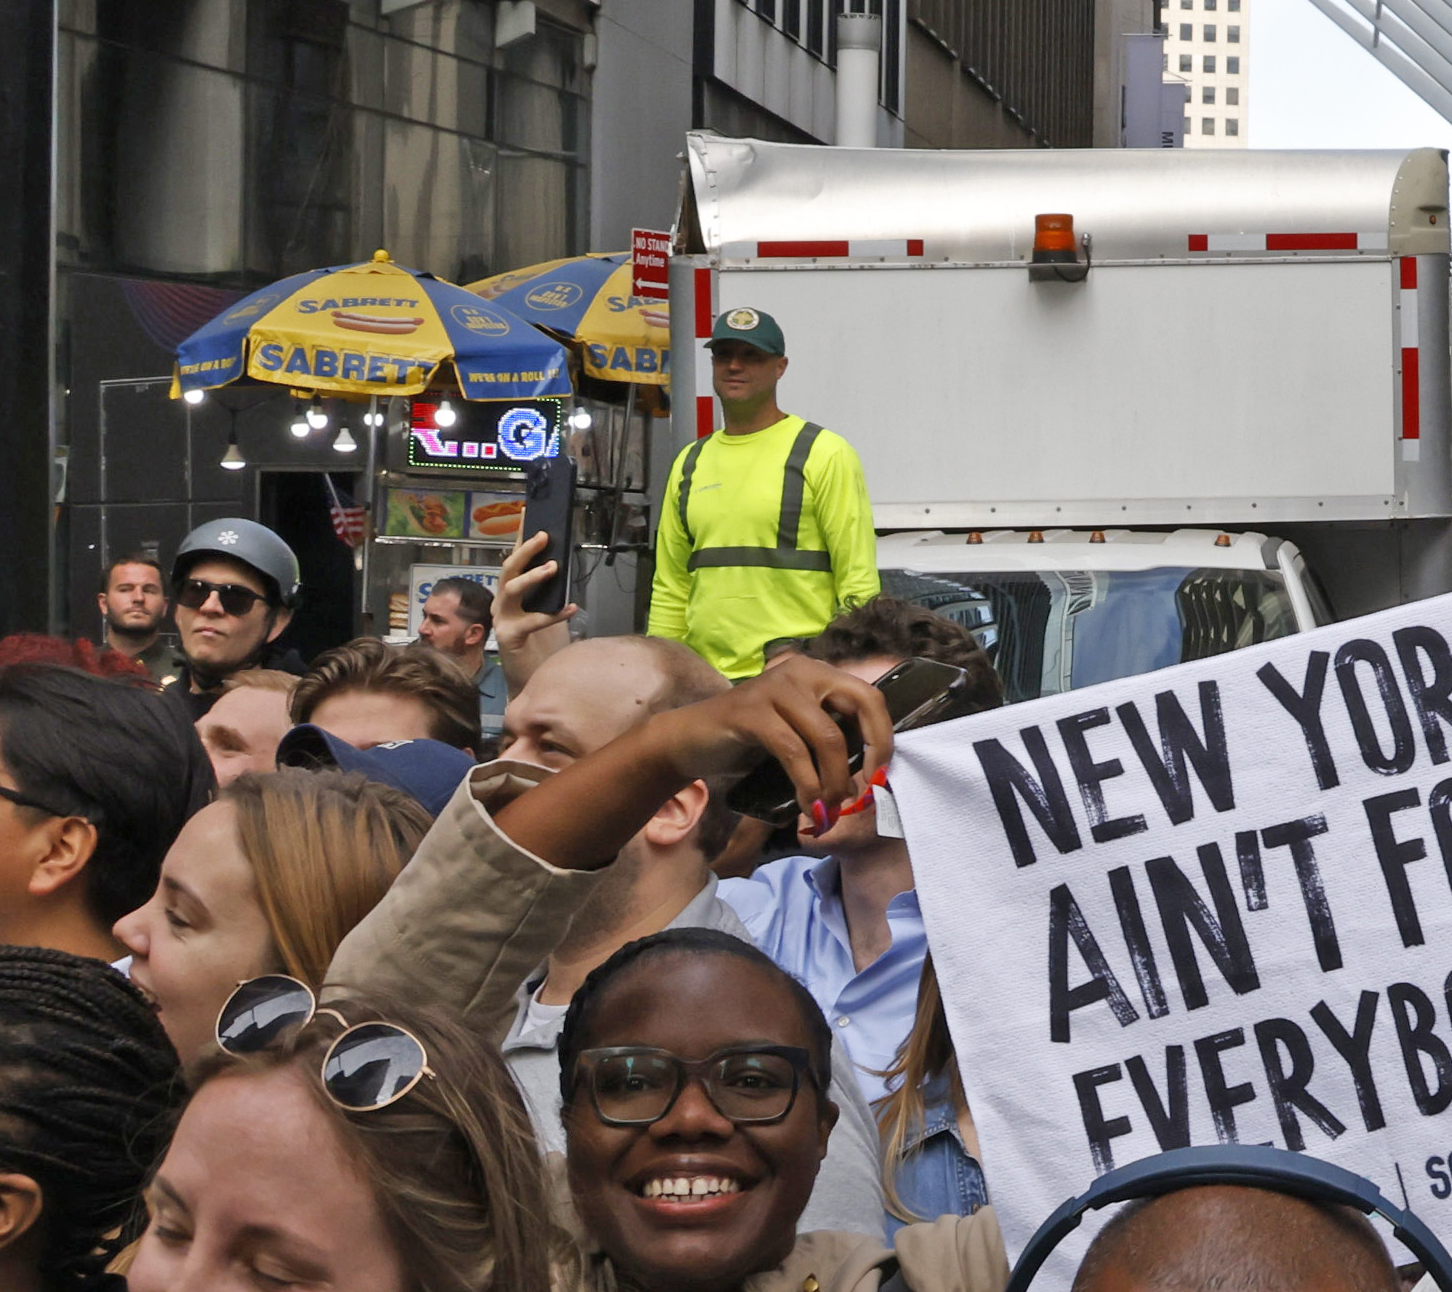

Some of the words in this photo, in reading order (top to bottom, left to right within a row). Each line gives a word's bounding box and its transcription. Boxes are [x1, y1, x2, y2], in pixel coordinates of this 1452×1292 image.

[635, 237, 646, 250] NO
[636, 253, 665, 268] Anytime
[295, 297, 421, 314] SABRETT
[497, 373, 511, 383] ON
[512, 372, 520, 382] A
[521, 371, 545, 382] ROLL
[972, 679, 1235, 869] NEW
[1049, 811, 1344, 1044] AIN'T
